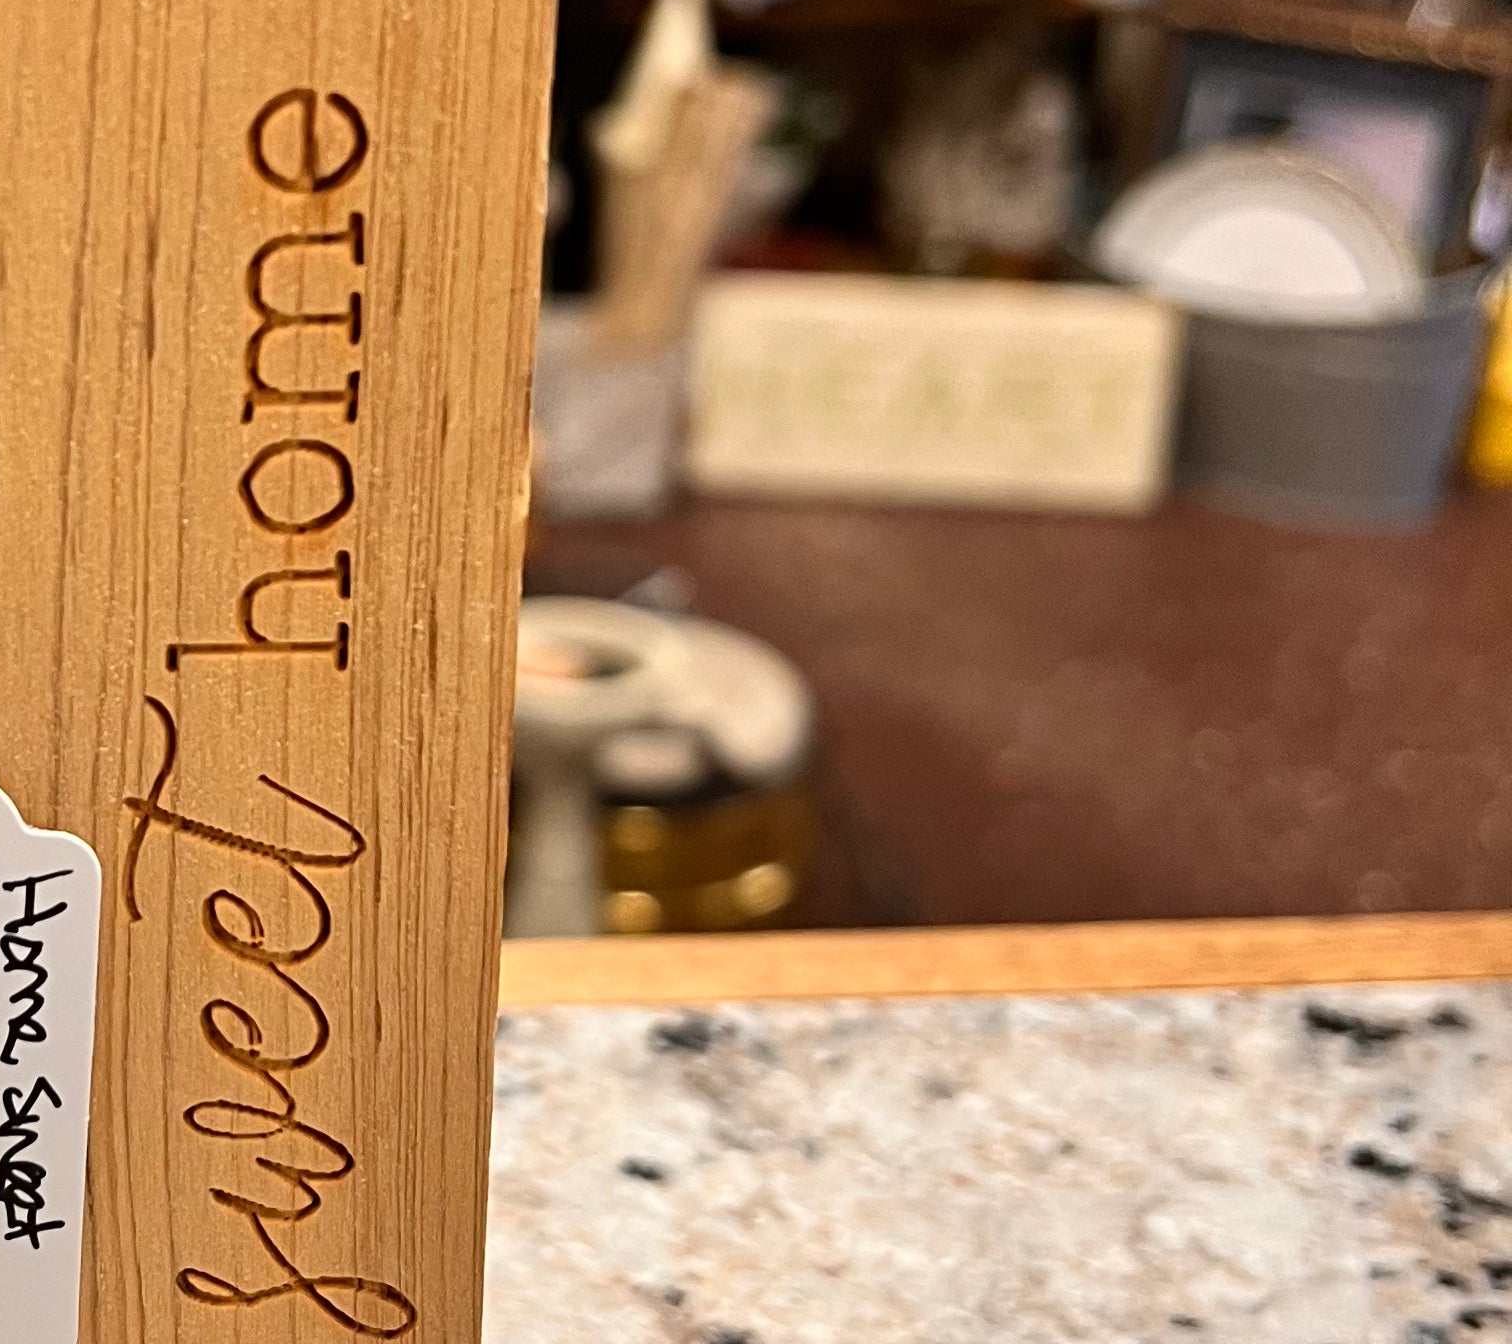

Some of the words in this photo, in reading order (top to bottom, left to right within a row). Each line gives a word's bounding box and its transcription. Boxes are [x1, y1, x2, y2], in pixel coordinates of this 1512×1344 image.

[165, 86, 370, 672] home
[0, 868, 74, 1066] Home
[122, 694, 419, 1341] sweet
